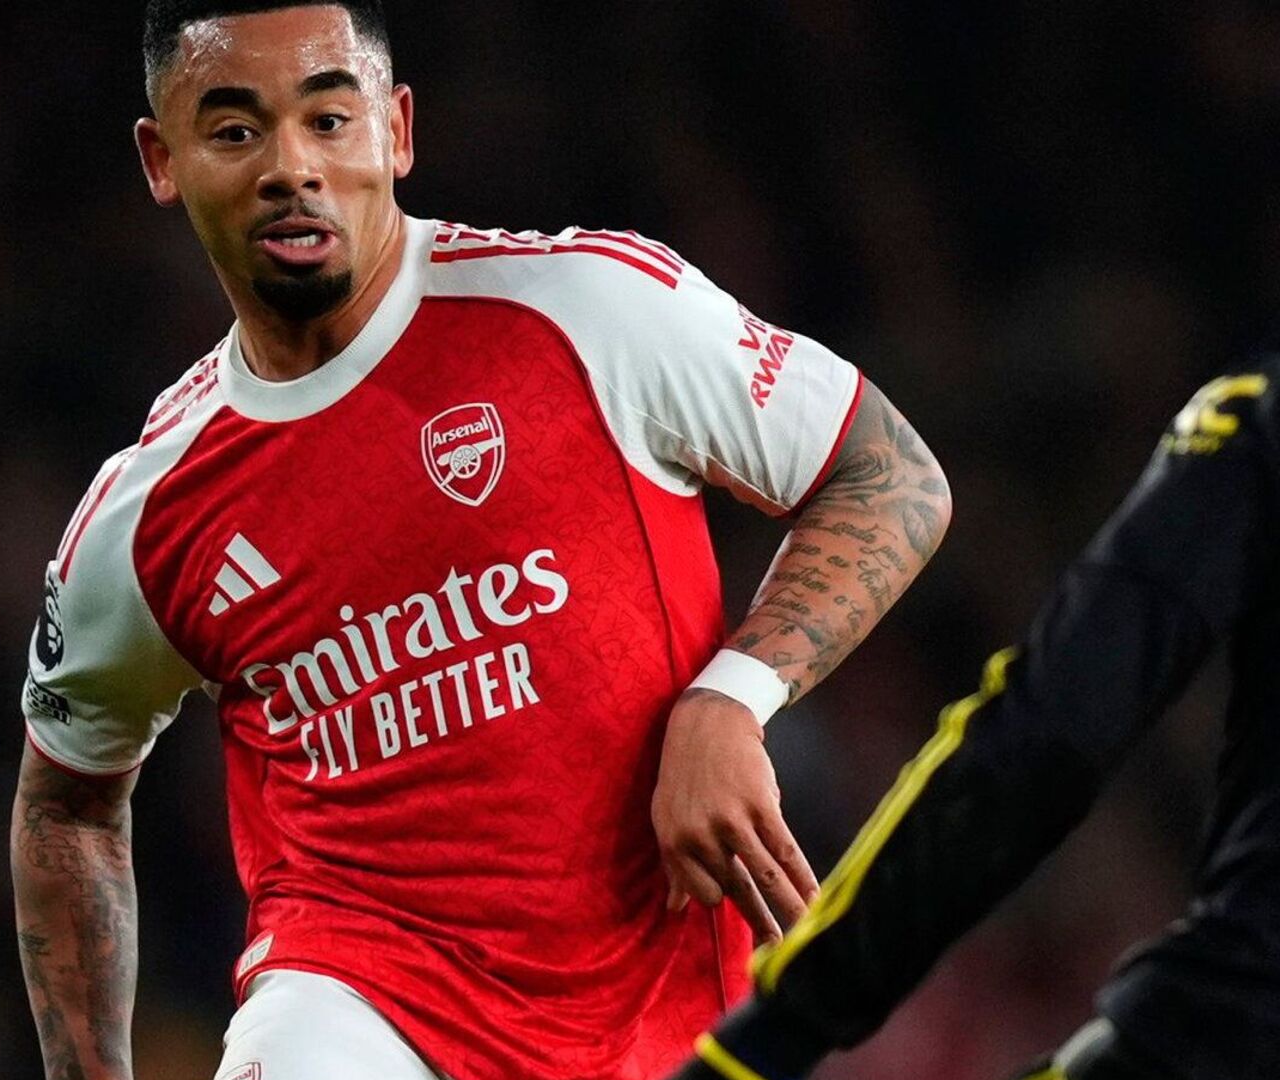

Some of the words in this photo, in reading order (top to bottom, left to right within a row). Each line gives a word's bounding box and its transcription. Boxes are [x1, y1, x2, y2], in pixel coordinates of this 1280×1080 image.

[431, 415, 489, 449] Arsenal
[240, 548, 570, 735] Emirates
[299, 704, 360, 782] FLY
[370, 642, 541, 760] BETTER
